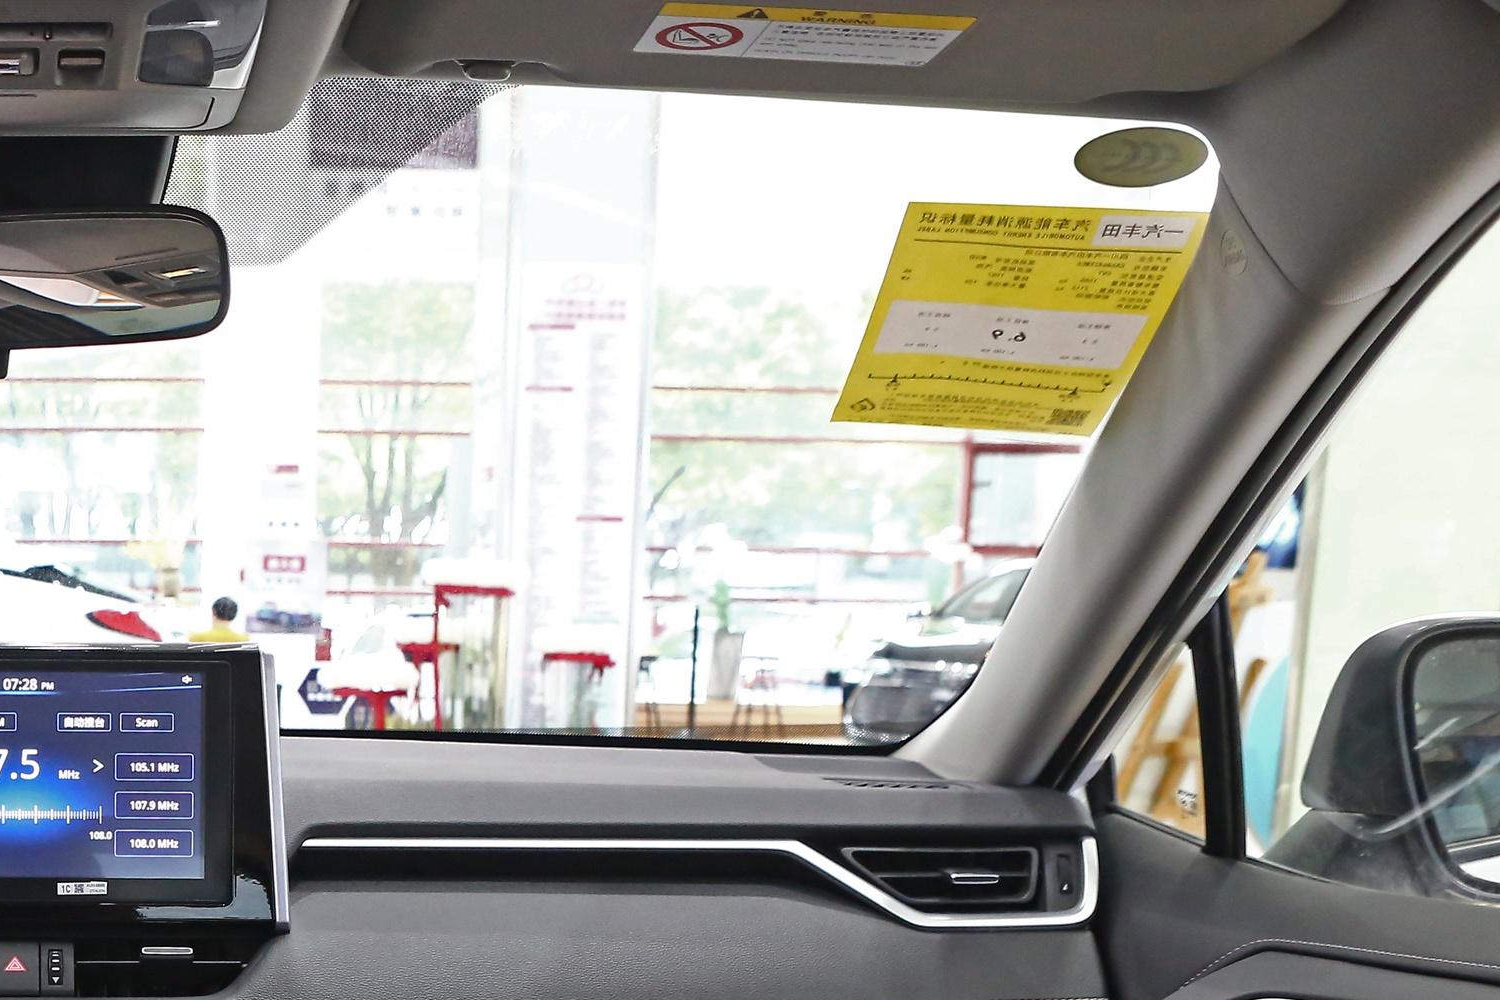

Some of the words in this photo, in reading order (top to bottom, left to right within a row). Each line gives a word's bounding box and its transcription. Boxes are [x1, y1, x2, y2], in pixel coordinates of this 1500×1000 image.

[800, 16, 876, 25] WARNING
[2, 678, 38, 691] 07:28
[41, 682, 55, 690] PM
[135, 717, 158, 728] Scan
[130, 762, 155, 773] 105.1
[157, 762, 180, 773] MHz
[58, 769, 81, 780] MHz
[130, 800, 156, 811] 107.9
[157, 800, 180, 811] MHz
[88, 831, 113, 841] 108.0
[129, 838, 156, 849] 108.0
[157, 838, 179, 849] MHz
[61, 884, 71, 893] 1C
